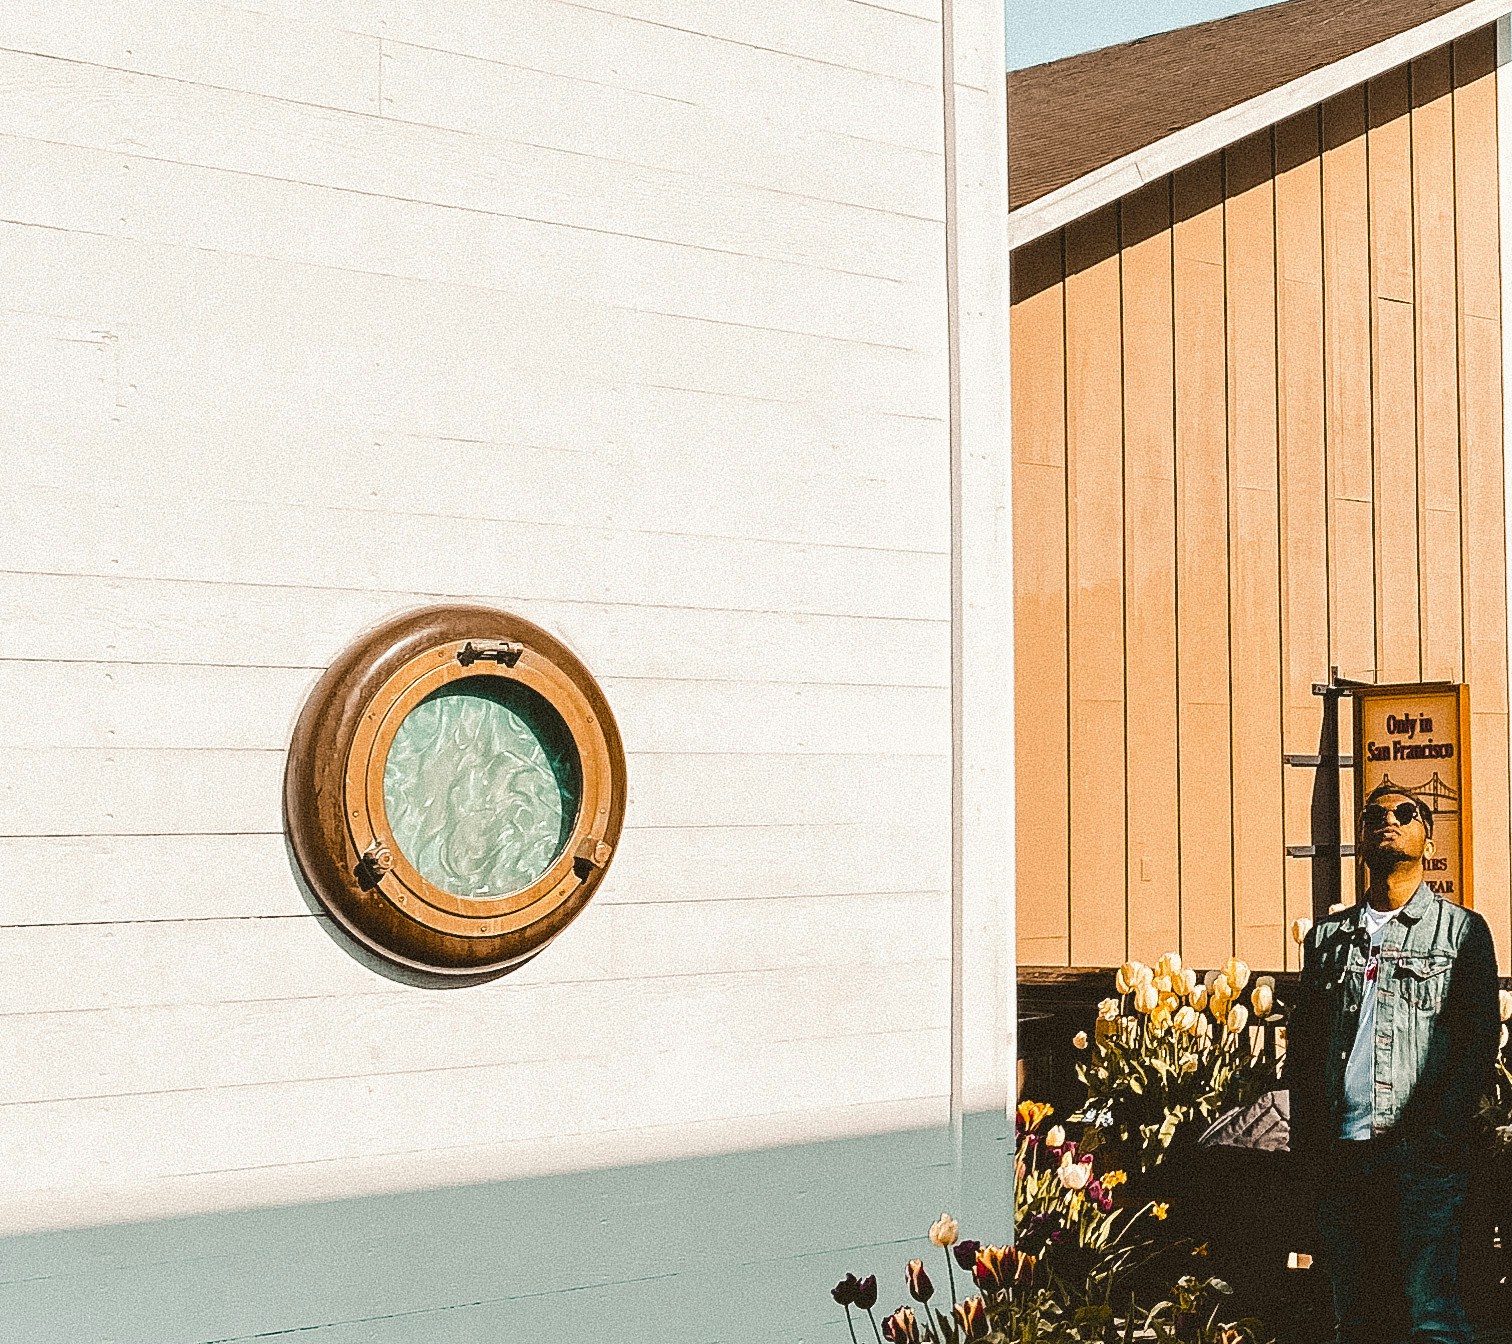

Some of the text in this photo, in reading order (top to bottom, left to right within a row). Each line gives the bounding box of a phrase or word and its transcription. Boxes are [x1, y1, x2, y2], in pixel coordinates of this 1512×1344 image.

[1386, 712, 1433, 739] Only in
[1367, 738, 1454, 762] San Francisco
